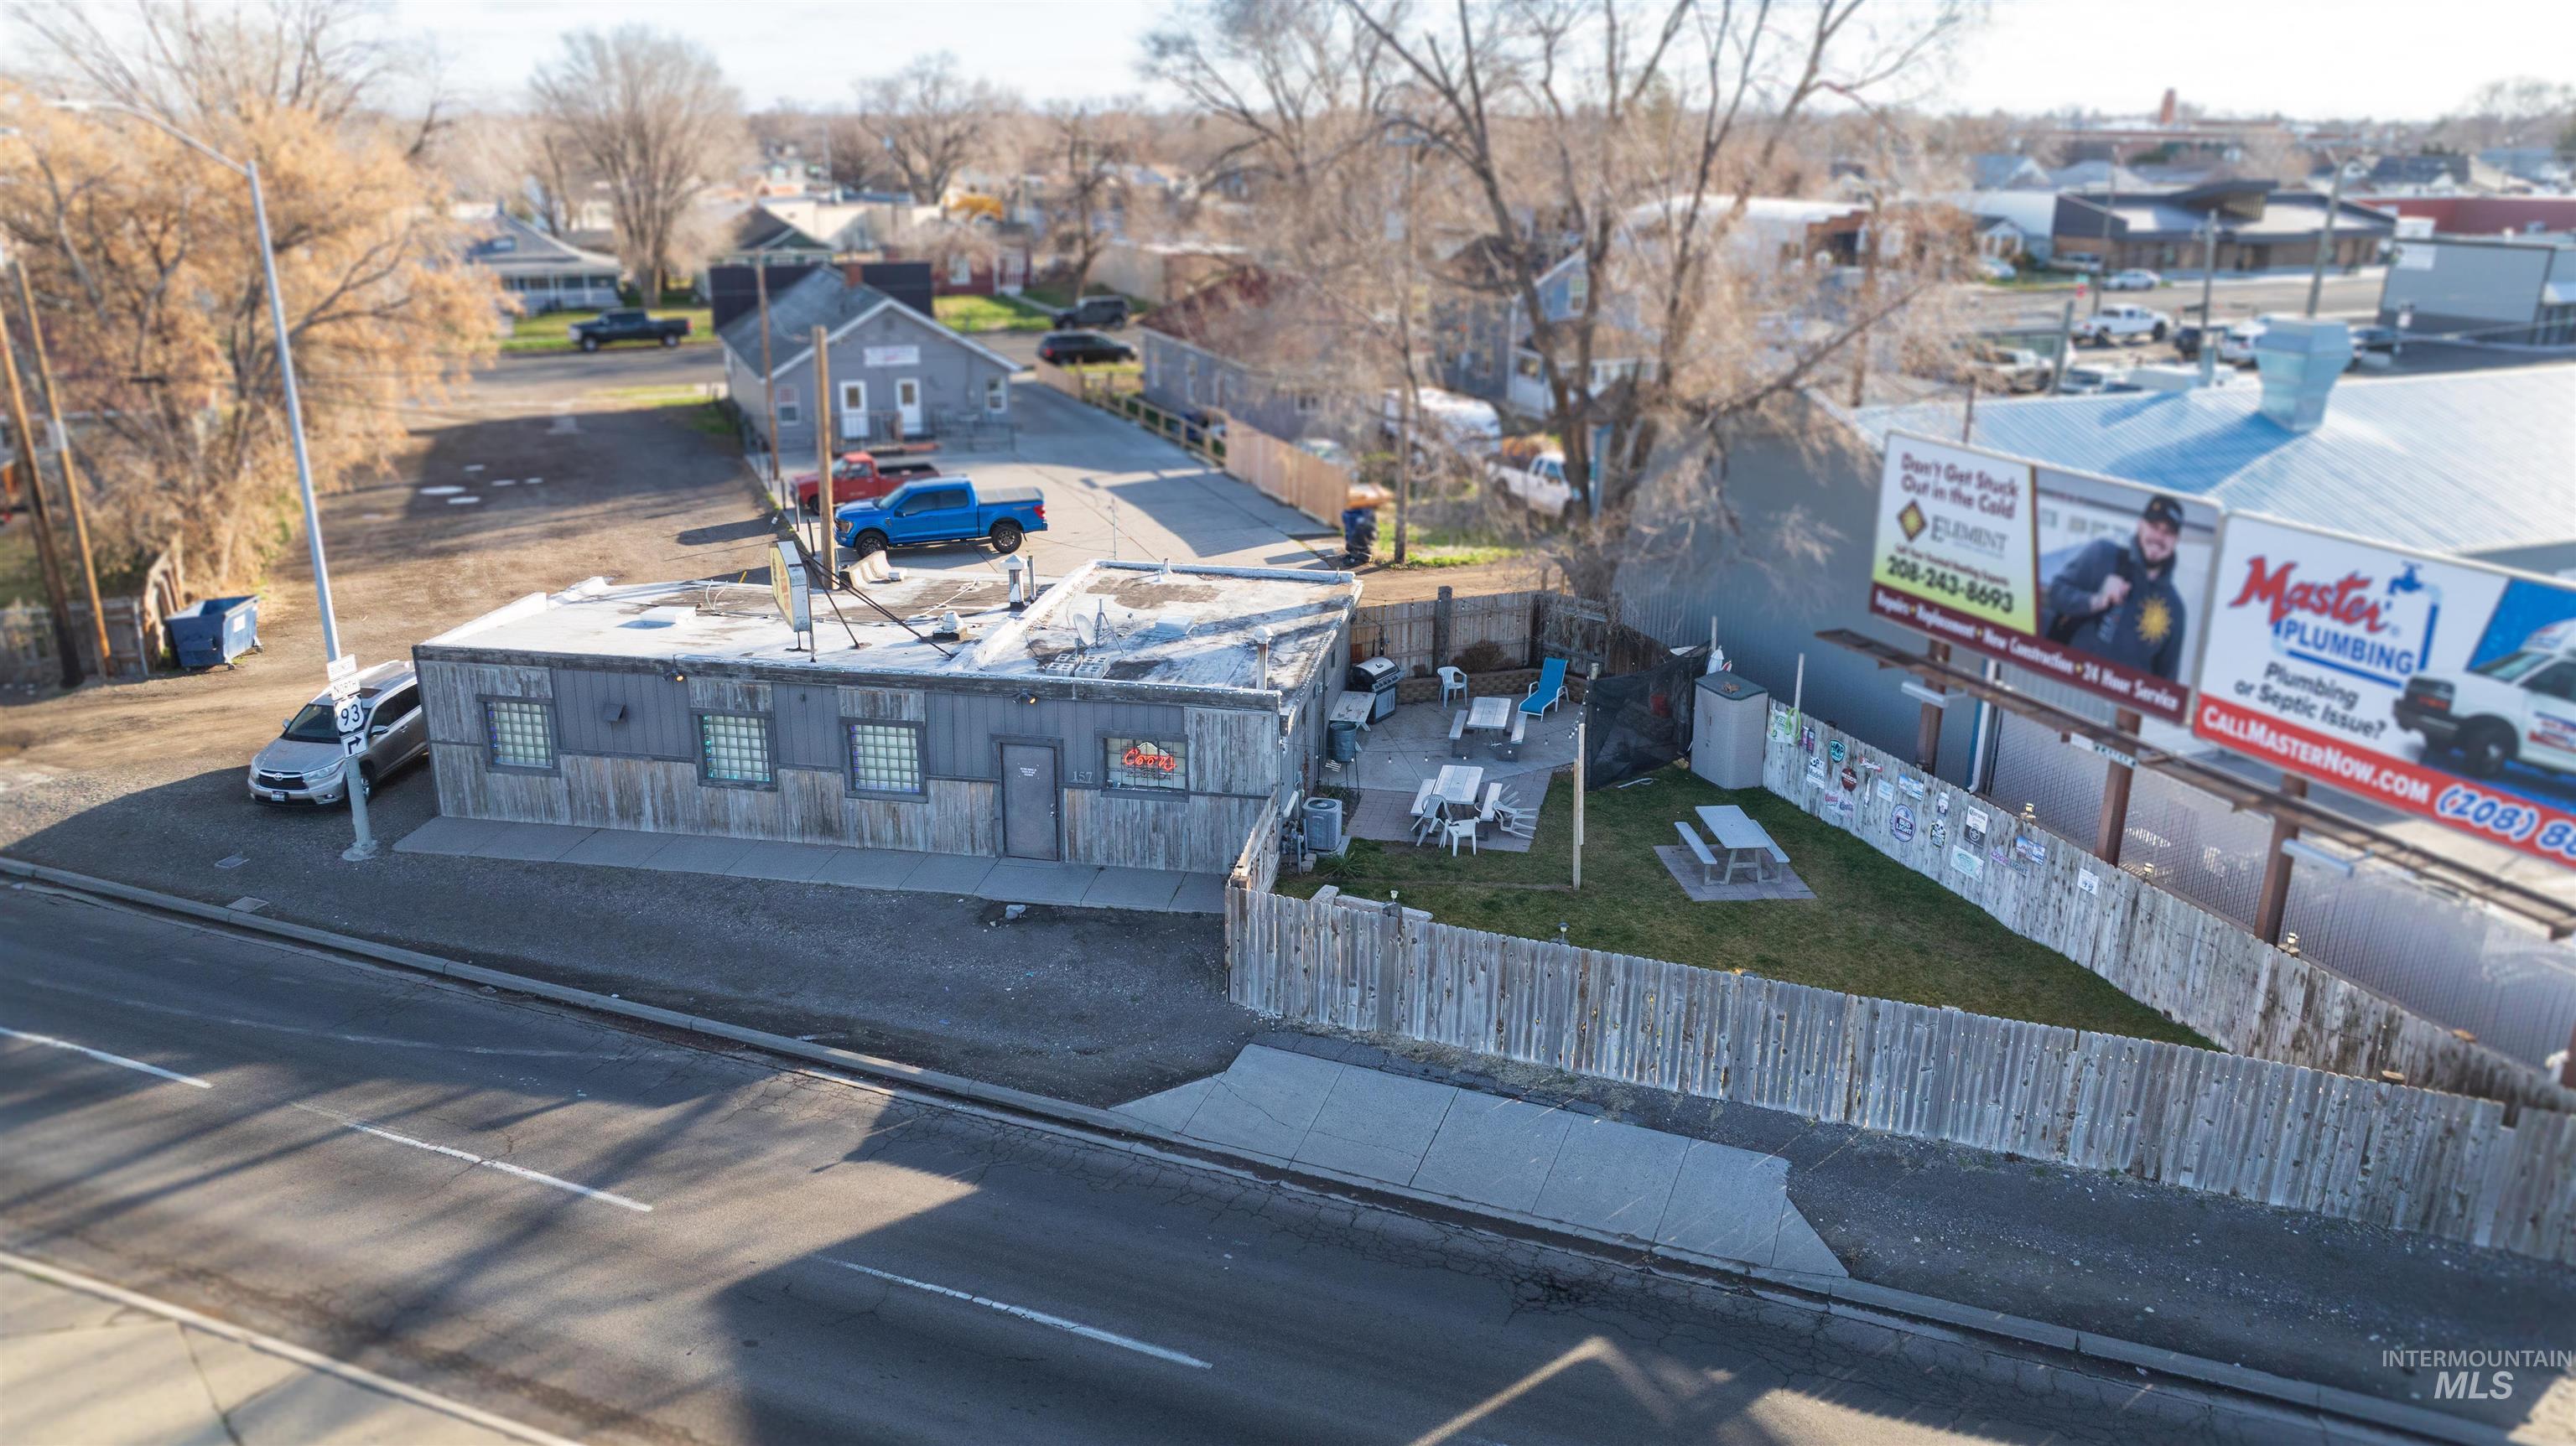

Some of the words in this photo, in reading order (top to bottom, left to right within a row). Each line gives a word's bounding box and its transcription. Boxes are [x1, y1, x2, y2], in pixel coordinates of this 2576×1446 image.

[1900, 452, 1942, 479] Don't
[1945, 463, 1973, 485] Get
[1976, 470, 2019, 497] Stuck
[1900, 474, 1929, 495] Out
[1932, 482, 1946, 500] in
[1950, 487, 1974, 508] the
[1977, 493, 2016, 520] Cold
[1887, 555, 2015, 614] 208-243-8693
[2227, 557, 2392, 634] Master
[1916, 604, 1976, 640] Replacement
[1982, 627, 2007, 650] New
[2009, 635, 2074, 674] Construction
[2083, 662, 2099, 684] 24
[2101, 668, 2131, 694] Hour
[2133, 679, 2179, 711] Service
[2283, 619, 2414, 675] PLUMBING
[334, 679, 357, 694] NORTH
[2235, 677, 2257, 696] or
[2257, 682, 2317, 722] Septic
[2321, 699, 2386, 739] Issue?
[2264, 662, 2360, 711] Plumbing
[340, 703, 361, 726] 93
[1072, 771, 1093, 781] 157
[1124, 748, 1177, 771] Coors
[1896, 823, 1913, 835] LIGHT
[1899, 819, 1910, 828] BUD
[2438, 785, 2537, 838] (208)
